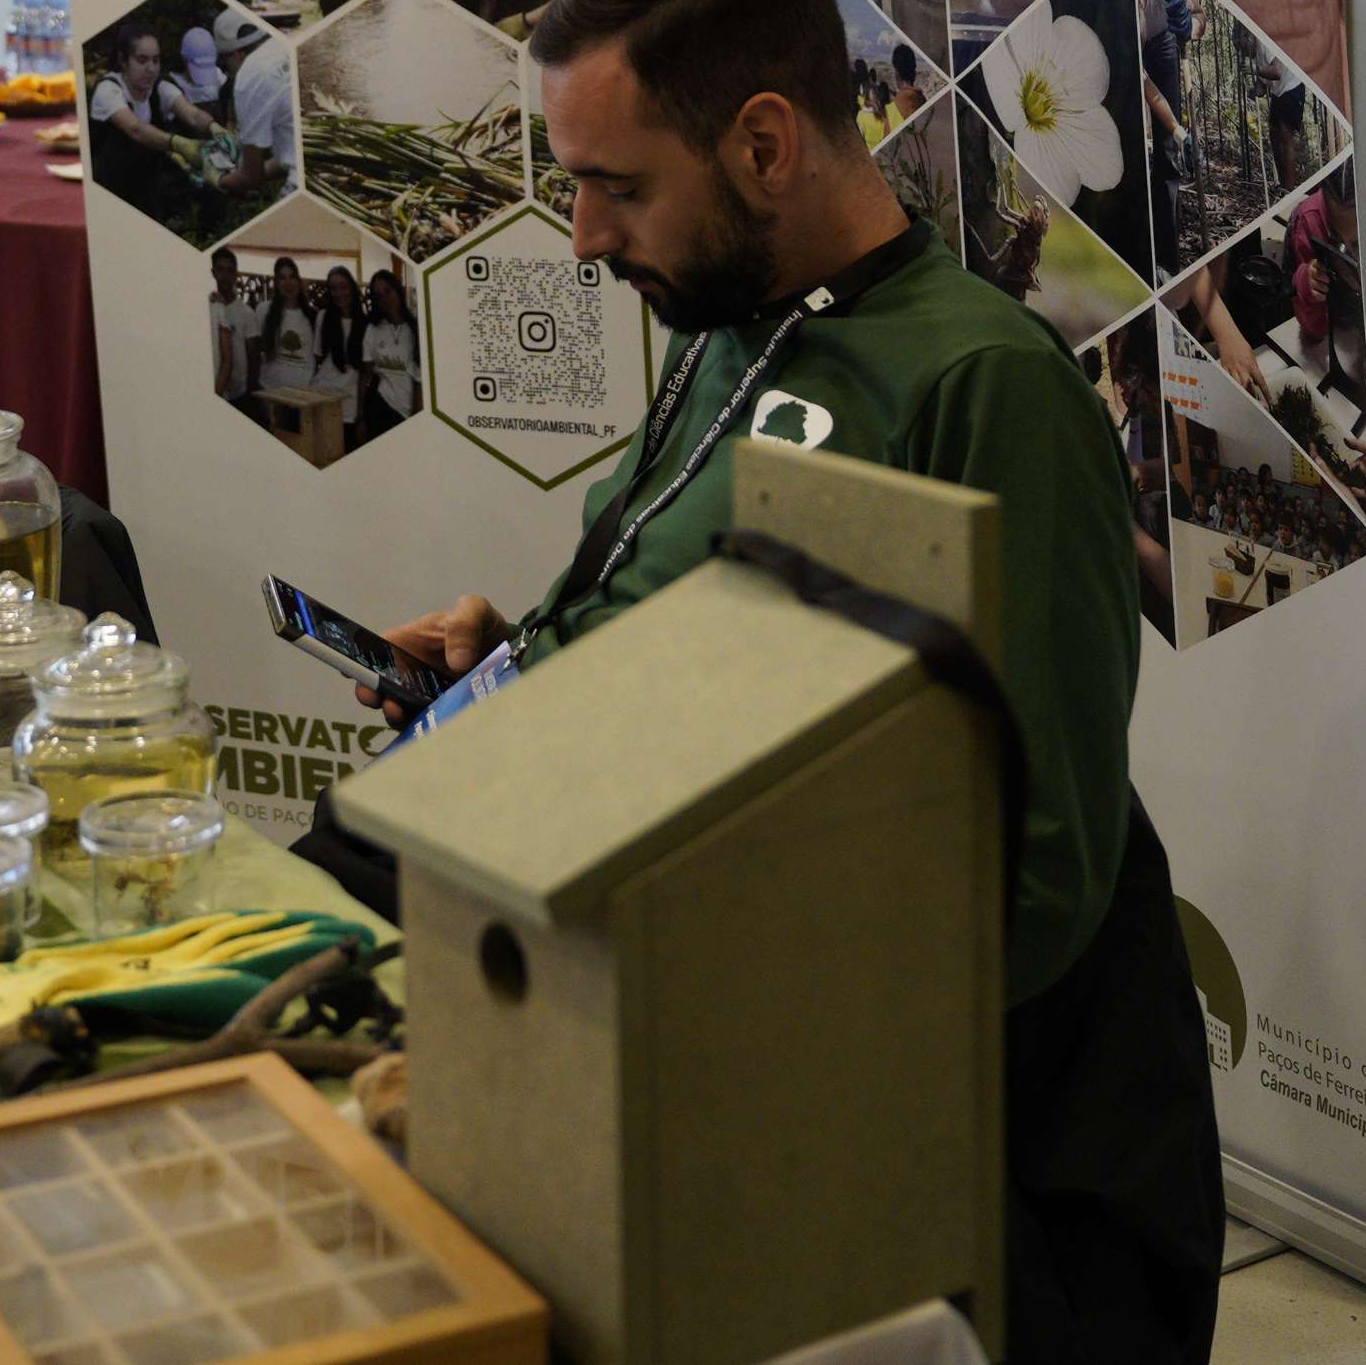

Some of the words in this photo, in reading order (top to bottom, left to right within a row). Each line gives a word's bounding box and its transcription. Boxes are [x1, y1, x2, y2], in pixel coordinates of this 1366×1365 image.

[764, 309, 804, 358] Instituto
[649, 391, 677, 439] Ciências
[667, 330, 708, 394] Educativas
[729, 355, 769, 409] Superior
[467, 415, 617, 438] OBSERVATORIOAMBIENTAL_PF
[718, 406, 731, 424] de
[685, 423, 721, 471] Ciências
[635, 469, 688, 524] Educativas
[245, 803, 268, 821] DE
[273, 807, 315, 828] PAÇ
[1256, 1013, 1352, 1070] Município
[1258, 1041, 1300, 1074] Paços
[1303, 1062, 1323, 1085] de
[1260, 1069, 1312, 1108] Câmara
